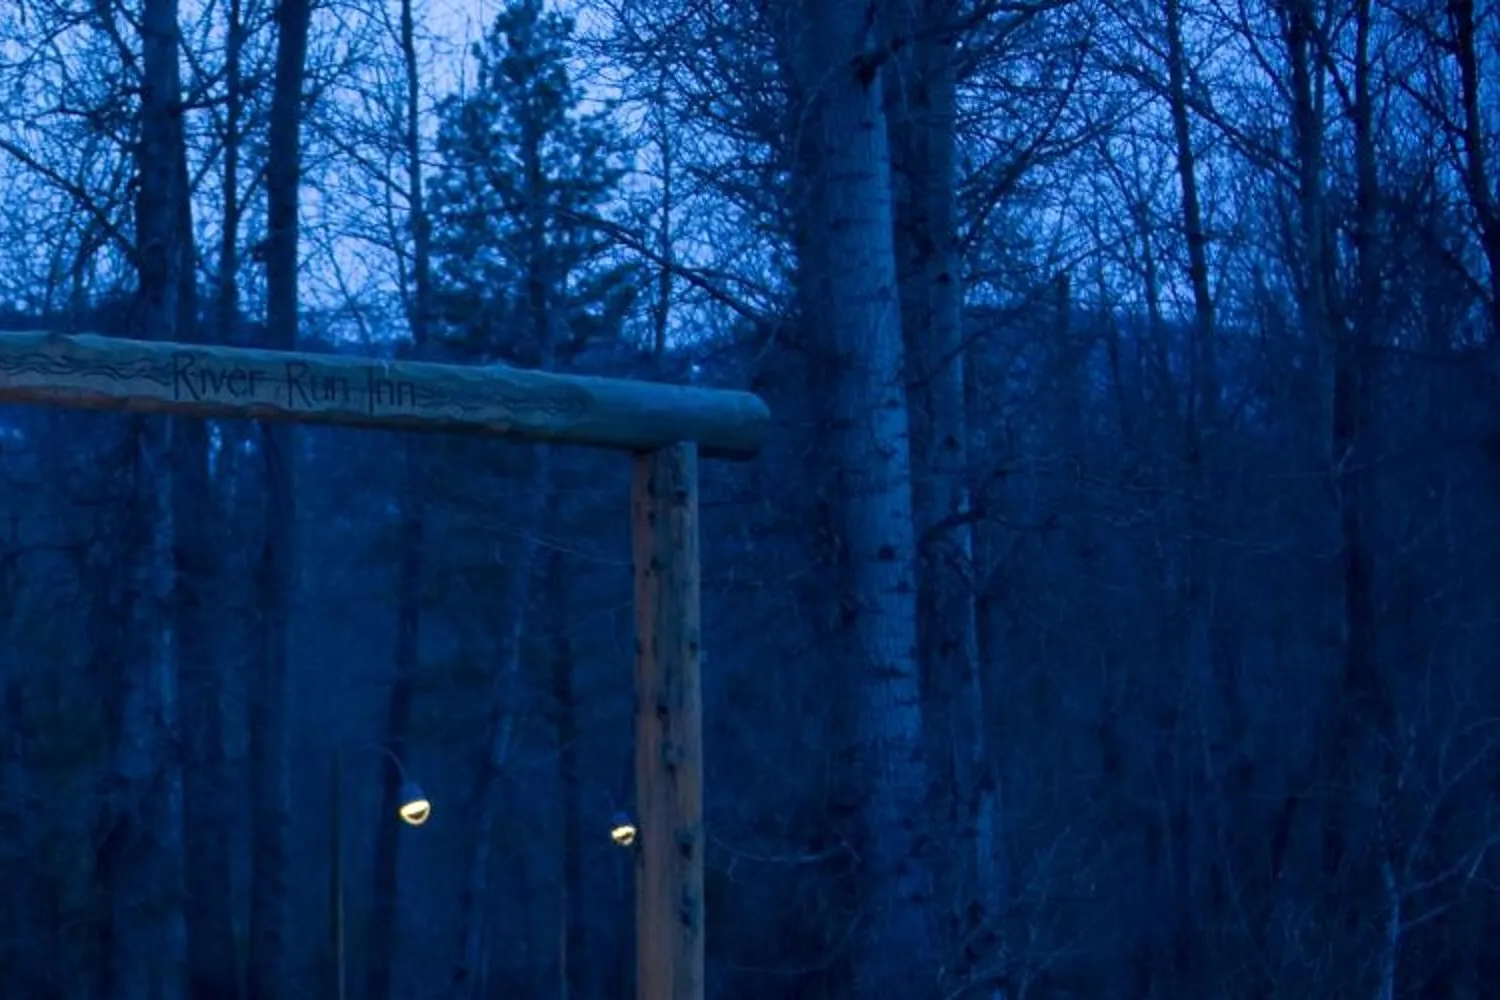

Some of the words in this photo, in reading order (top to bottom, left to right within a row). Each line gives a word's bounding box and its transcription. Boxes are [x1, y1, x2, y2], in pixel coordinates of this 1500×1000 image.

[171, 350, 263, 402] River
[284, 360, 351, 409] Run
[365, 365, 417, 415] Inn
